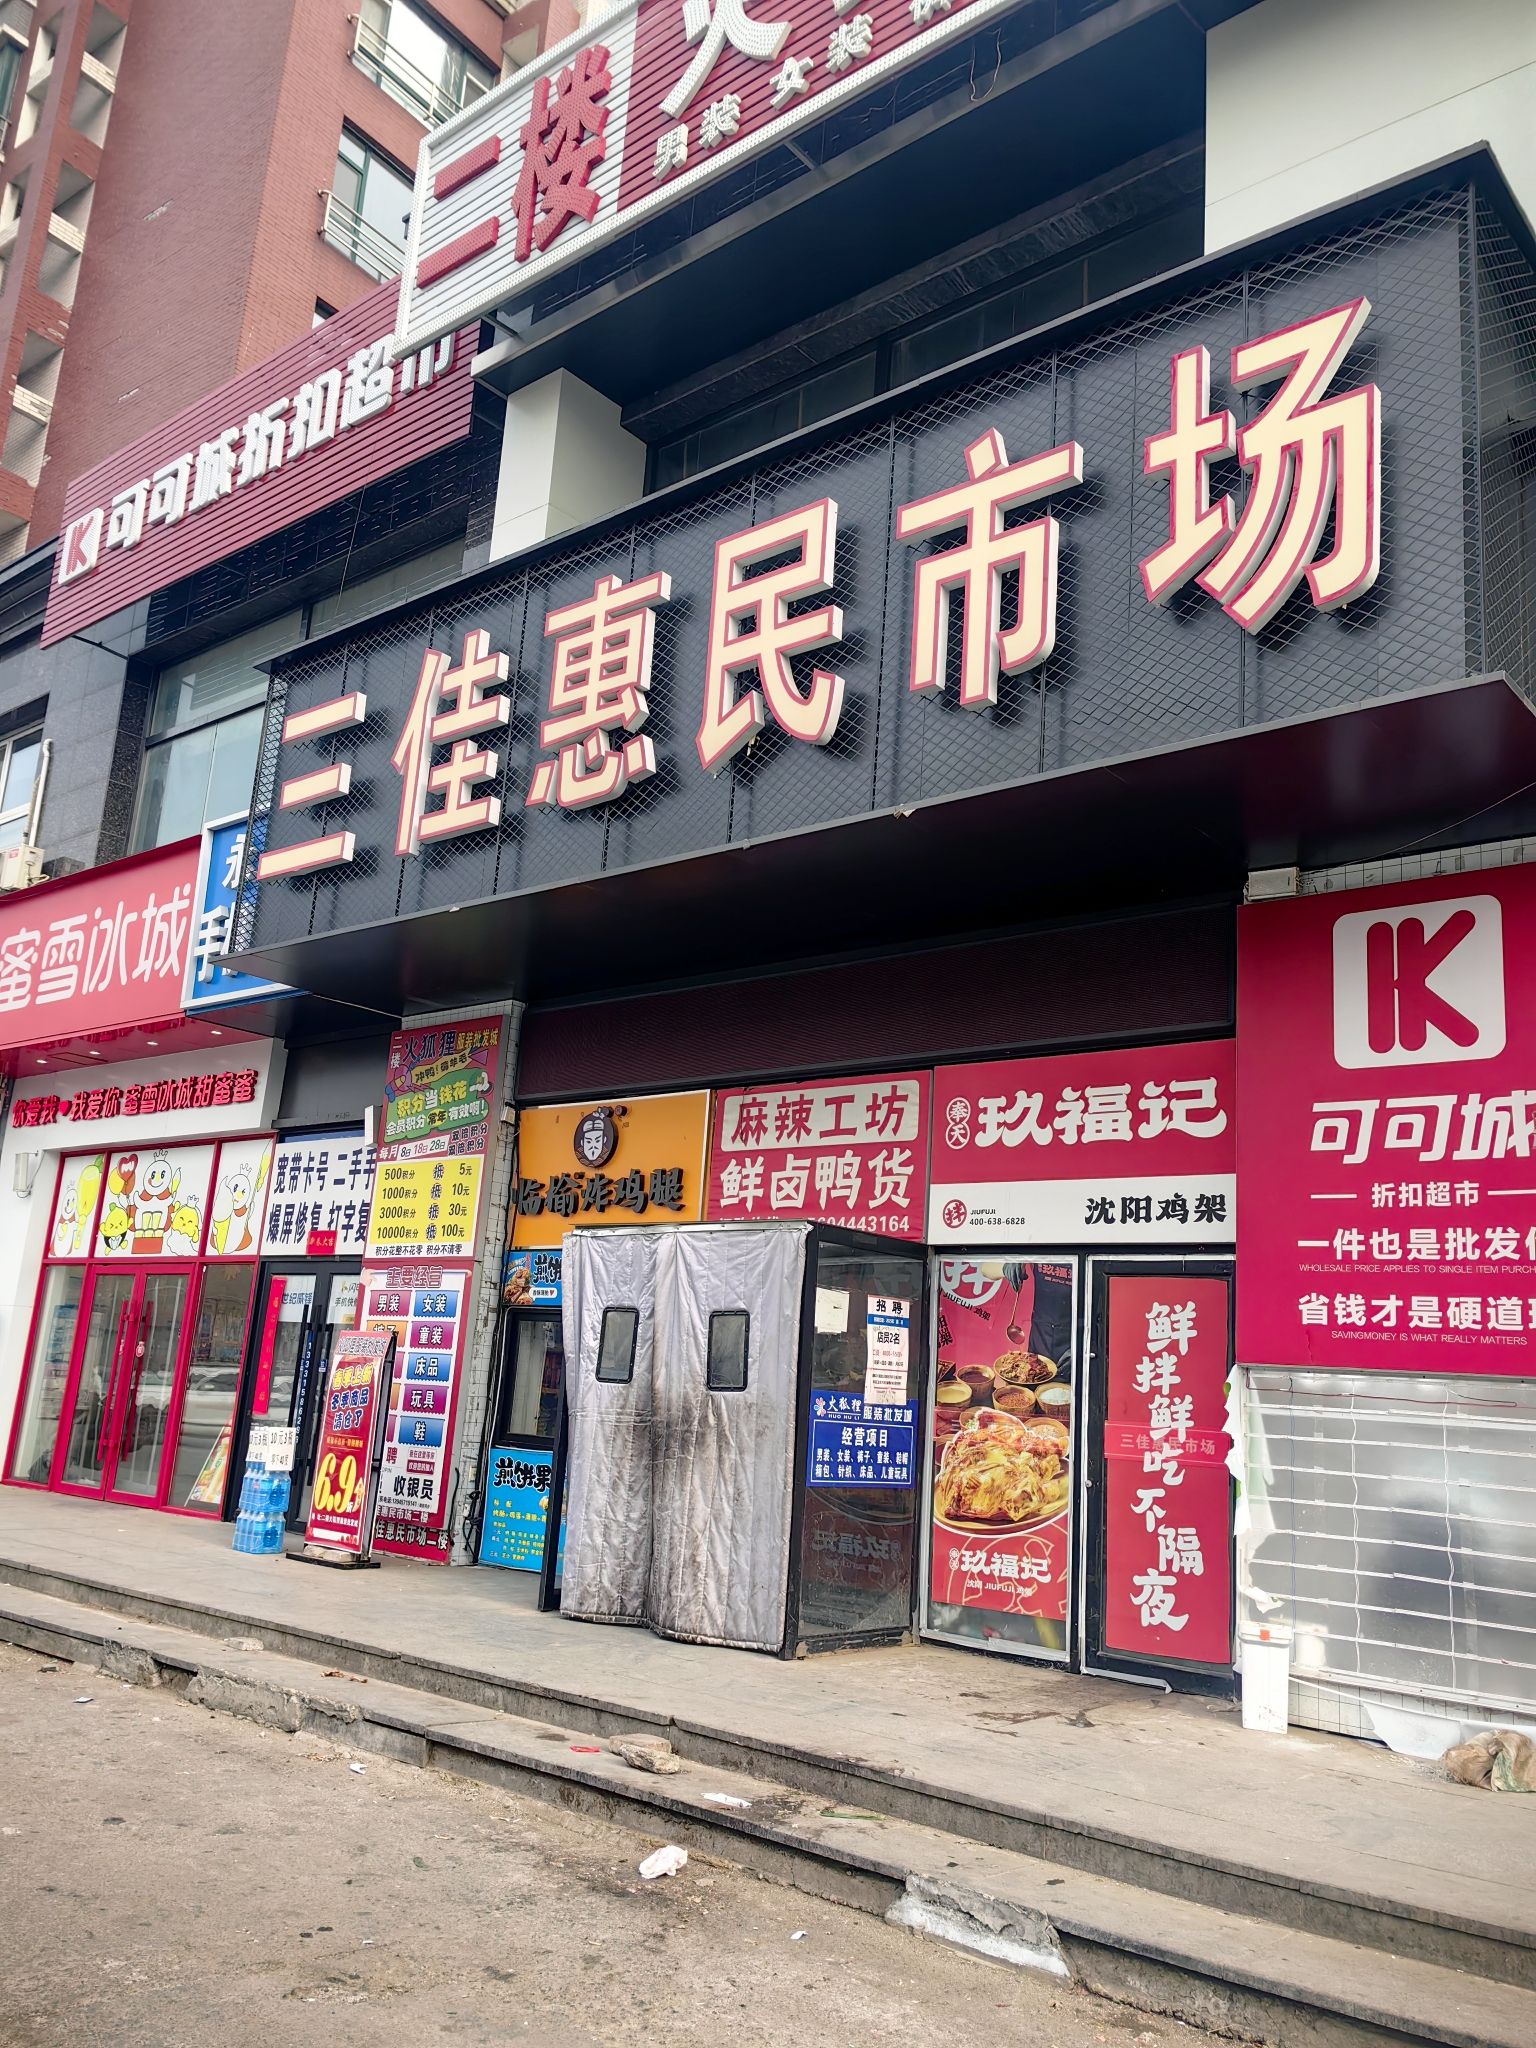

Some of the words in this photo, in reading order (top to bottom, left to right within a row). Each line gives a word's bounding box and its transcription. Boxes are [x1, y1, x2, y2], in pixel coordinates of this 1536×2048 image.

[416, 44, 612, 288] 二楼
[257, 296, 1382, 879] 三佳惠民市场
[0, 883, 191, 1012] 蜜雪冰城
[69, 1087, 122, 1121] 我爱你
[121, 1069, 258, 1115] 蜜雪冰城甜蜜蜜
[397, 1081, 467, 1119] 积分当钱花
[730, 1084, 910, 1147] 麻辣工坊
[948, 1098, 970, 1149] 奉天
[975, 1076, 1227, 1147] 玖福记
[1309, 1089, 1536, 1164] 可可城
[274, 1151, 329, 1194] 宽带卡号
[385, 1168, 415, 1180] 500积分
[459, 1163, 472, 1176] 5元
[719, 1148, 914, 1211] 鲜卤鸭货
[382, 1187, 418, 1199] 1000积分
[452, 1183, 470, 1196] 10元
[1371, 1180, 1480, 1208] 折扣超市
[380, 1206, 416, 1219] 3000积分
[448, 1203, 467, 1216] 30元
[1084, 1192, 1227, 1225] 沈阳鸡架
[377, 1226, 419, 1239] 10000积分
[441, 1224, 464, 1238] 100元
[969, 1217, 1026, 1226] 400-638-6828
[386, 1266, 443, 1288] 主要经营
[1299, 1264, 1351, 1272] WHOLESALE
[1354, 1264, 1380, 1273] PRICE
[1383, 1265, 1420, 1273] APPLIES
[1424, 1265, 1436, 1273] TO
[1439, 1265, 1472, 1274] SINGLE
[1476, 1265, 1498, 1274] ITEM
[377, 1295, 400, 1312] 男装
[423, 1295, 447, 1313] 女装
[876, 1299, 903, 1314] 招聘
[419, 1326, 443, 1345] 童装
[1331, 1331, 1397, 1341] SAVINGMONEY
[1400, 1332, 1408, 1341] IS
[1411, 1333, 1437, 1342] WHAT
[1441, 1334, 1476, 1344] REALLY
[1480, 1336, 1528, 1345] MATTERS
[415, 1358, 438, 1377] 床品
[411, 1391, 434, 1409] 玩具
[827, 1396, 861, 1412] 火狐狸
[863, 1406, 912, 1422] 服装批发城
[414, 1422, 426, 1440] 鞋
[842, 1427, 888, 1447] 经营项目
[1130, 1301, 1204, 1631] 鲜拌鲜吃不隔夜
[394, 1475, 434, 1500] 收银员
[961, 1550, 1052, 1583] 玖福记
